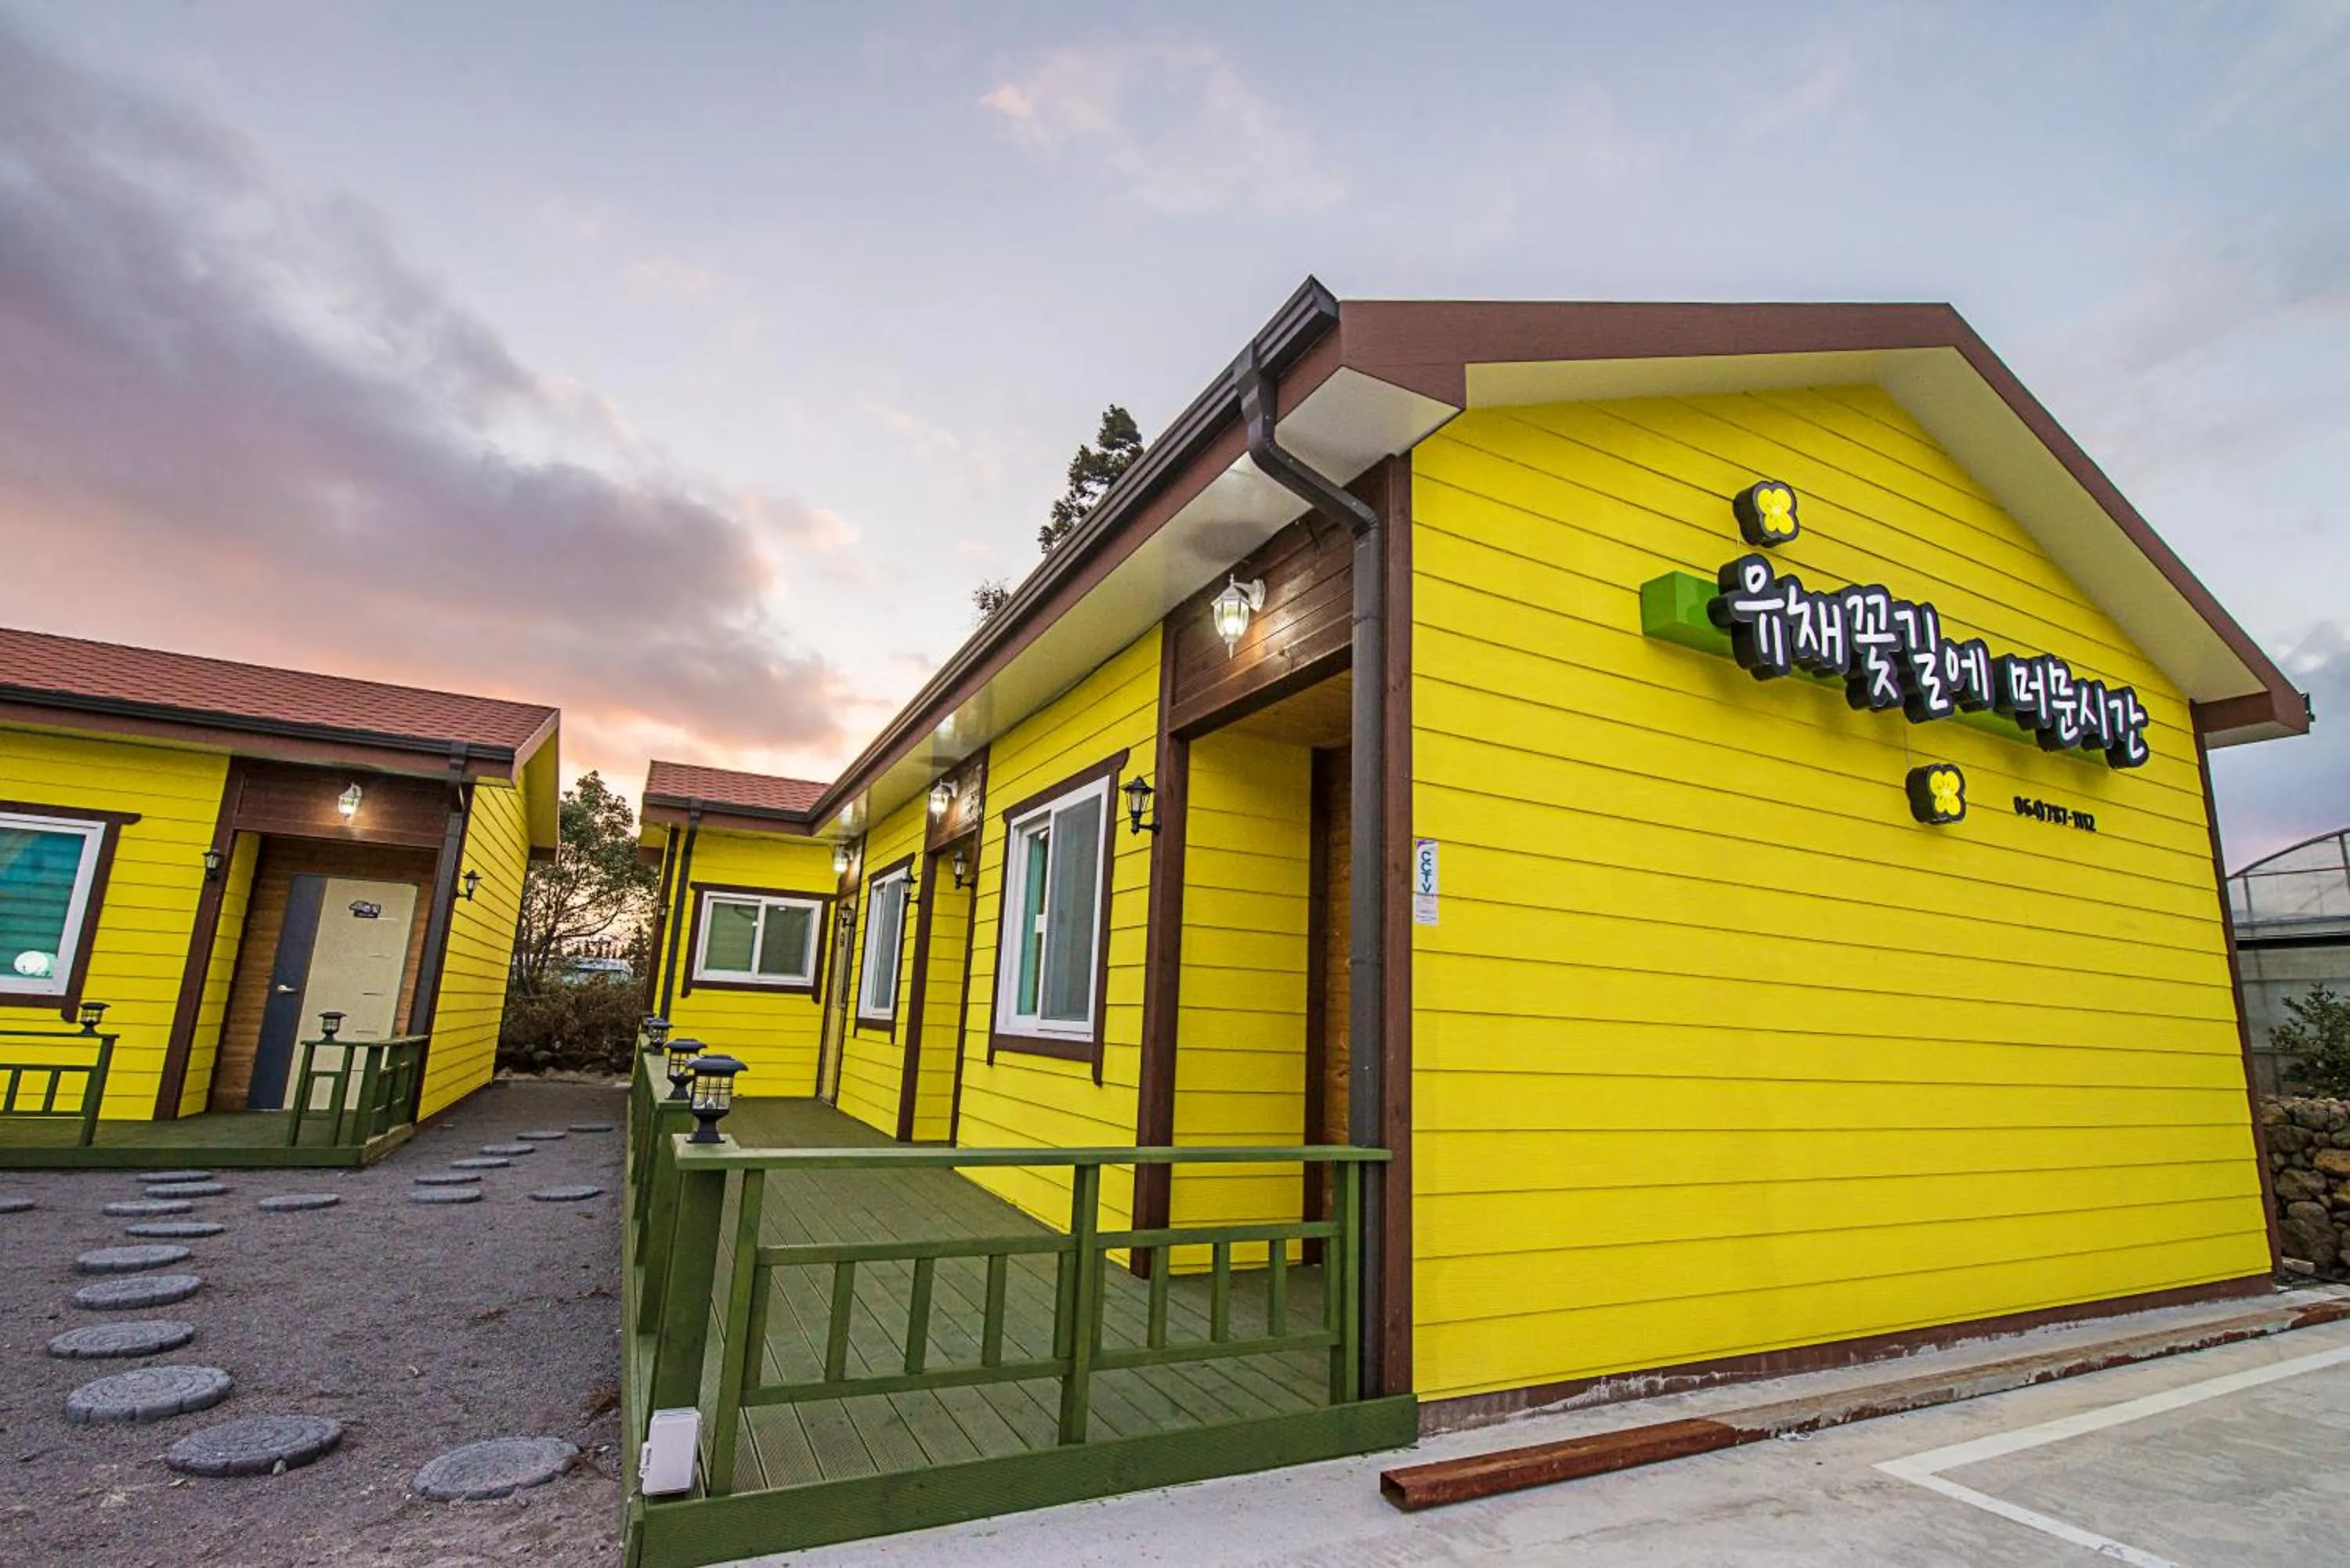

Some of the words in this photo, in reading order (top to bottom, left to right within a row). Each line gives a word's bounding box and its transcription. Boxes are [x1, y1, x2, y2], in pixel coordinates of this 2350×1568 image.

[1734, 564, 1990, 710] 유채꽃길에
[2009, 662, 2146, 760] 머문시간
[1420, 850, 1432, 892] CCTV
